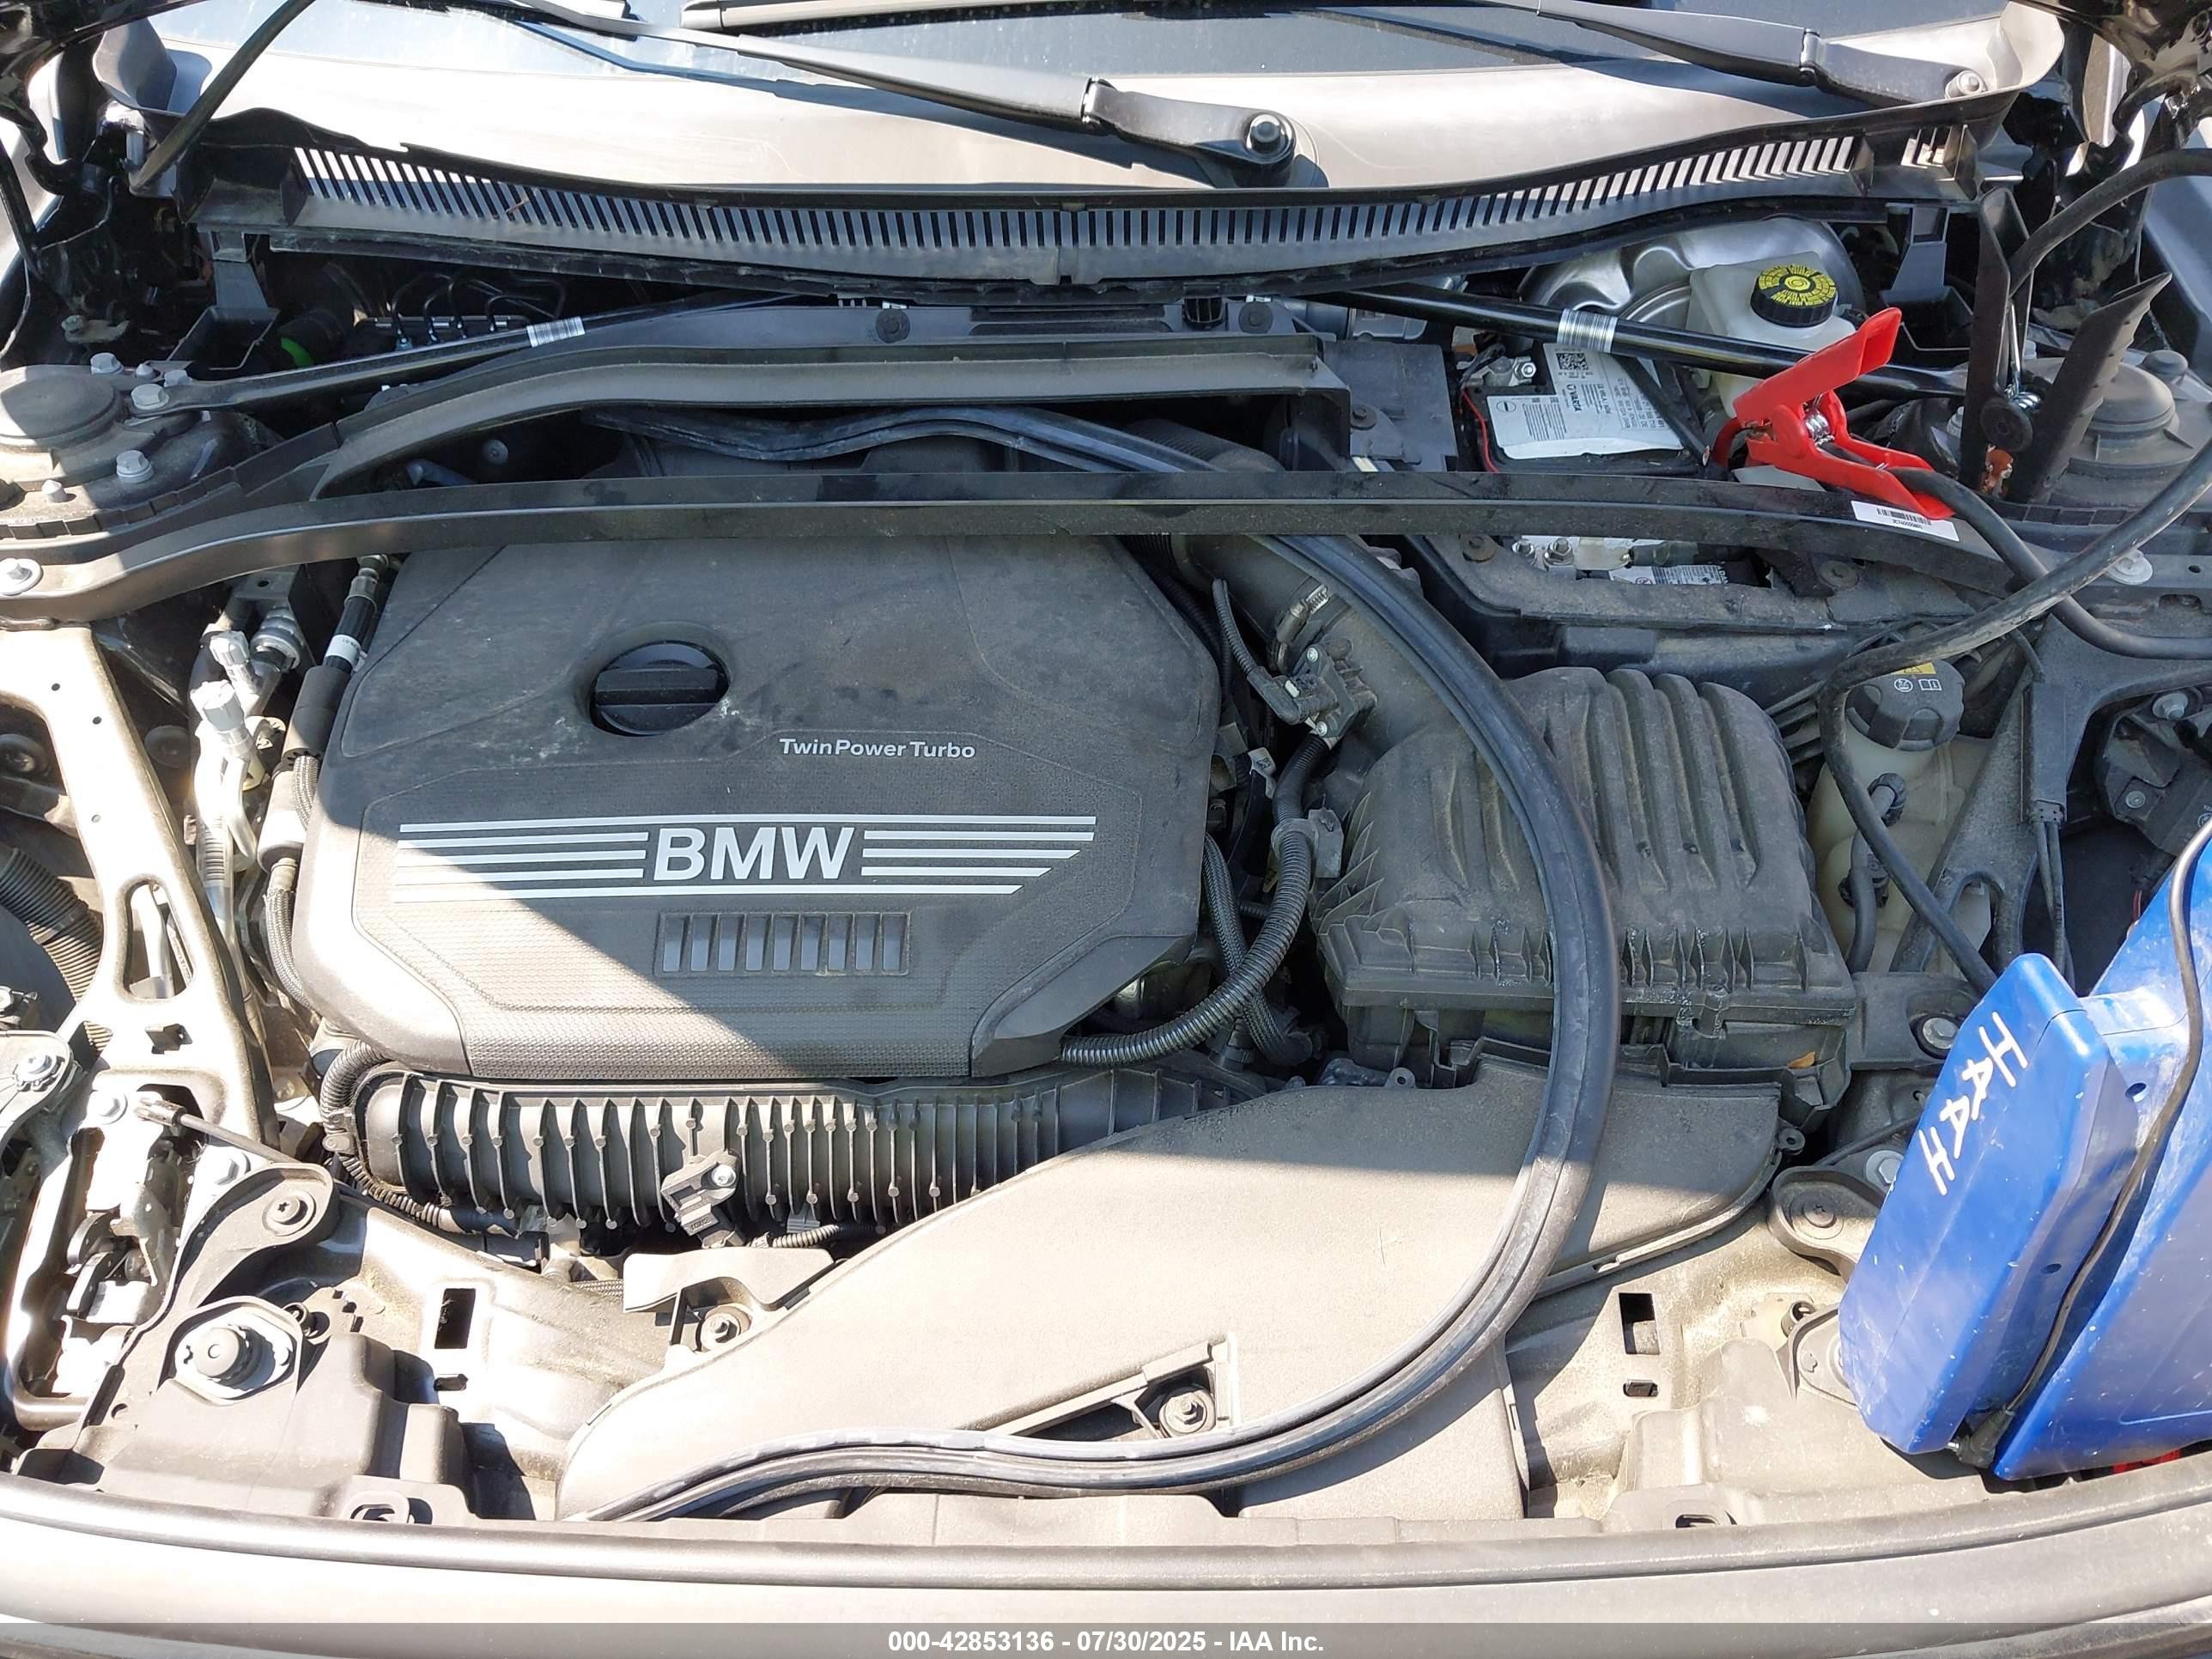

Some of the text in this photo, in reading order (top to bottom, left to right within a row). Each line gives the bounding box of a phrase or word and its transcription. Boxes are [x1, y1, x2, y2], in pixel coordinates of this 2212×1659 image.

[1570, 389, 1583, 412] VARTA
[909, 741, 976, 758] Turbo
[653, 826, 855, 881] BMW
